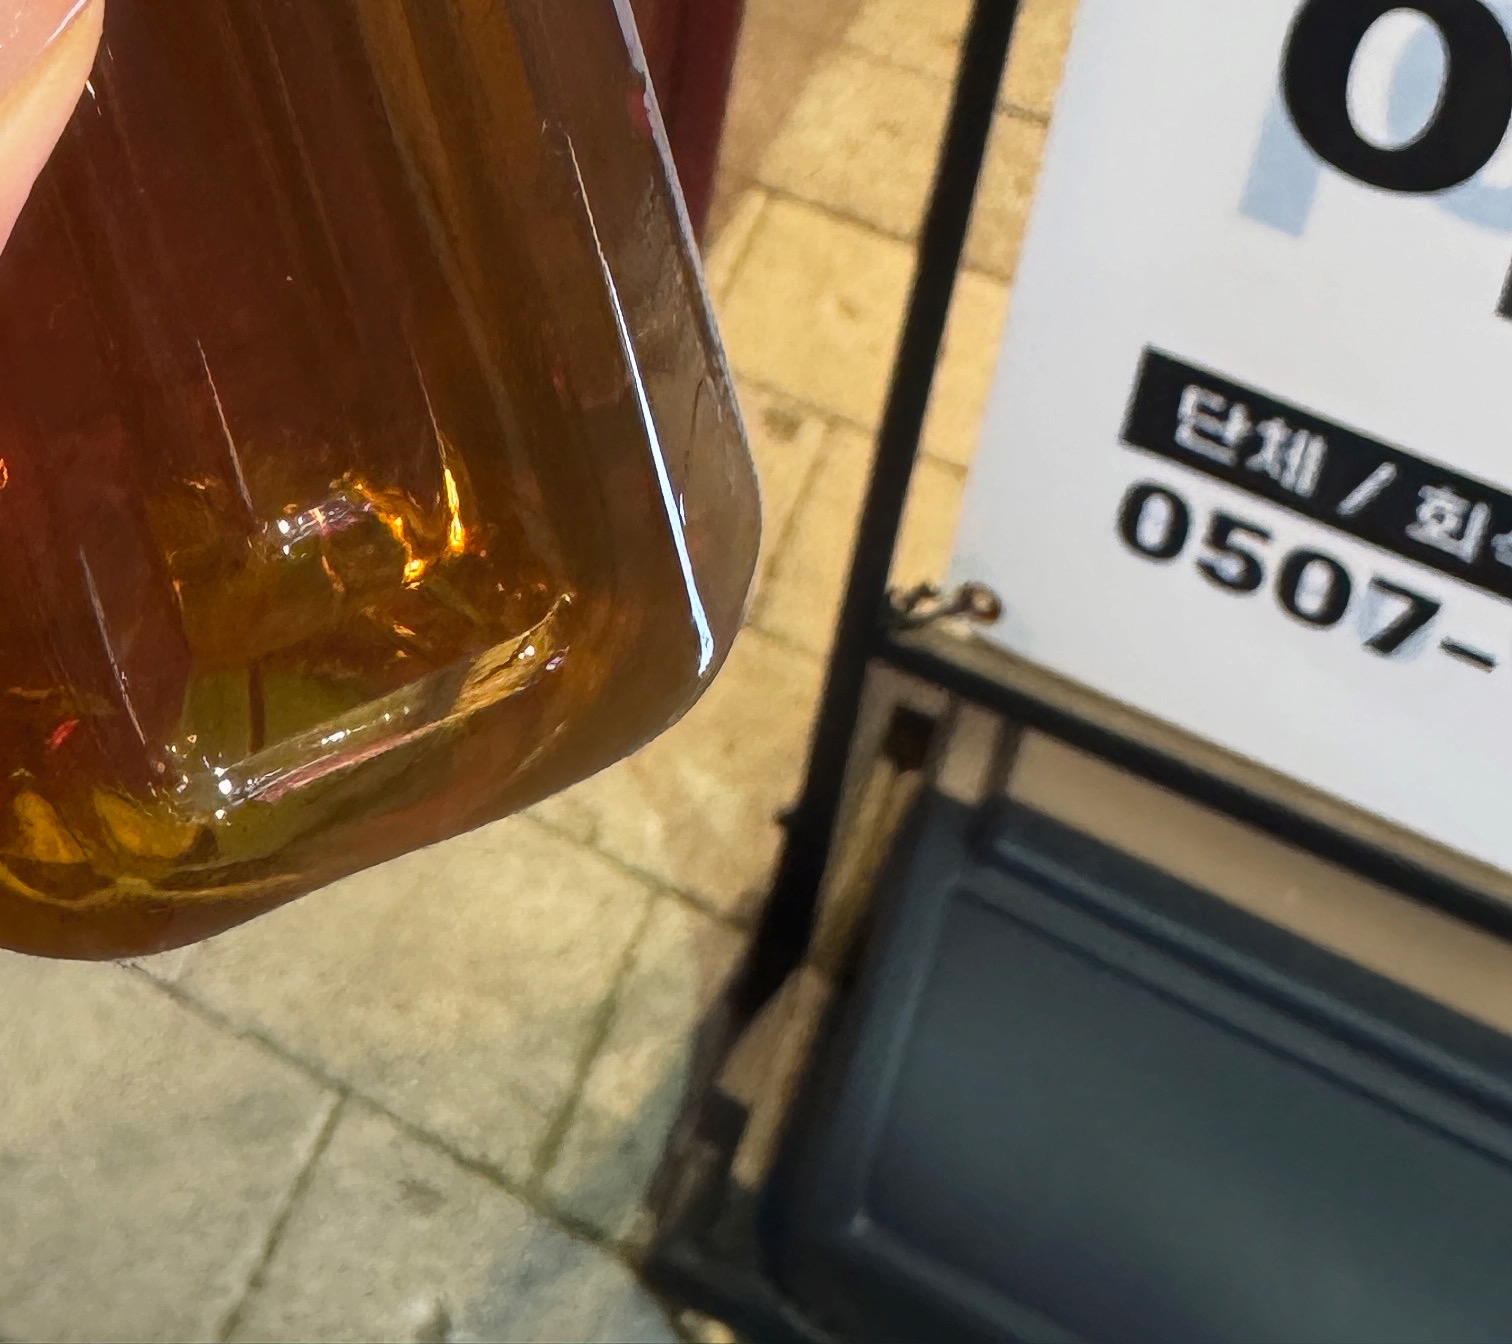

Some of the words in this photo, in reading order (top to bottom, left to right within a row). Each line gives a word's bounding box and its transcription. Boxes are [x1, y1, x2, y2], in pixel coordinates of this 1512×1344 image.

[1174, 383, 1329, 499] 단체
[1404, 483, 1512, 565] 회
[1117, 480, 1497, 672] 0507-
